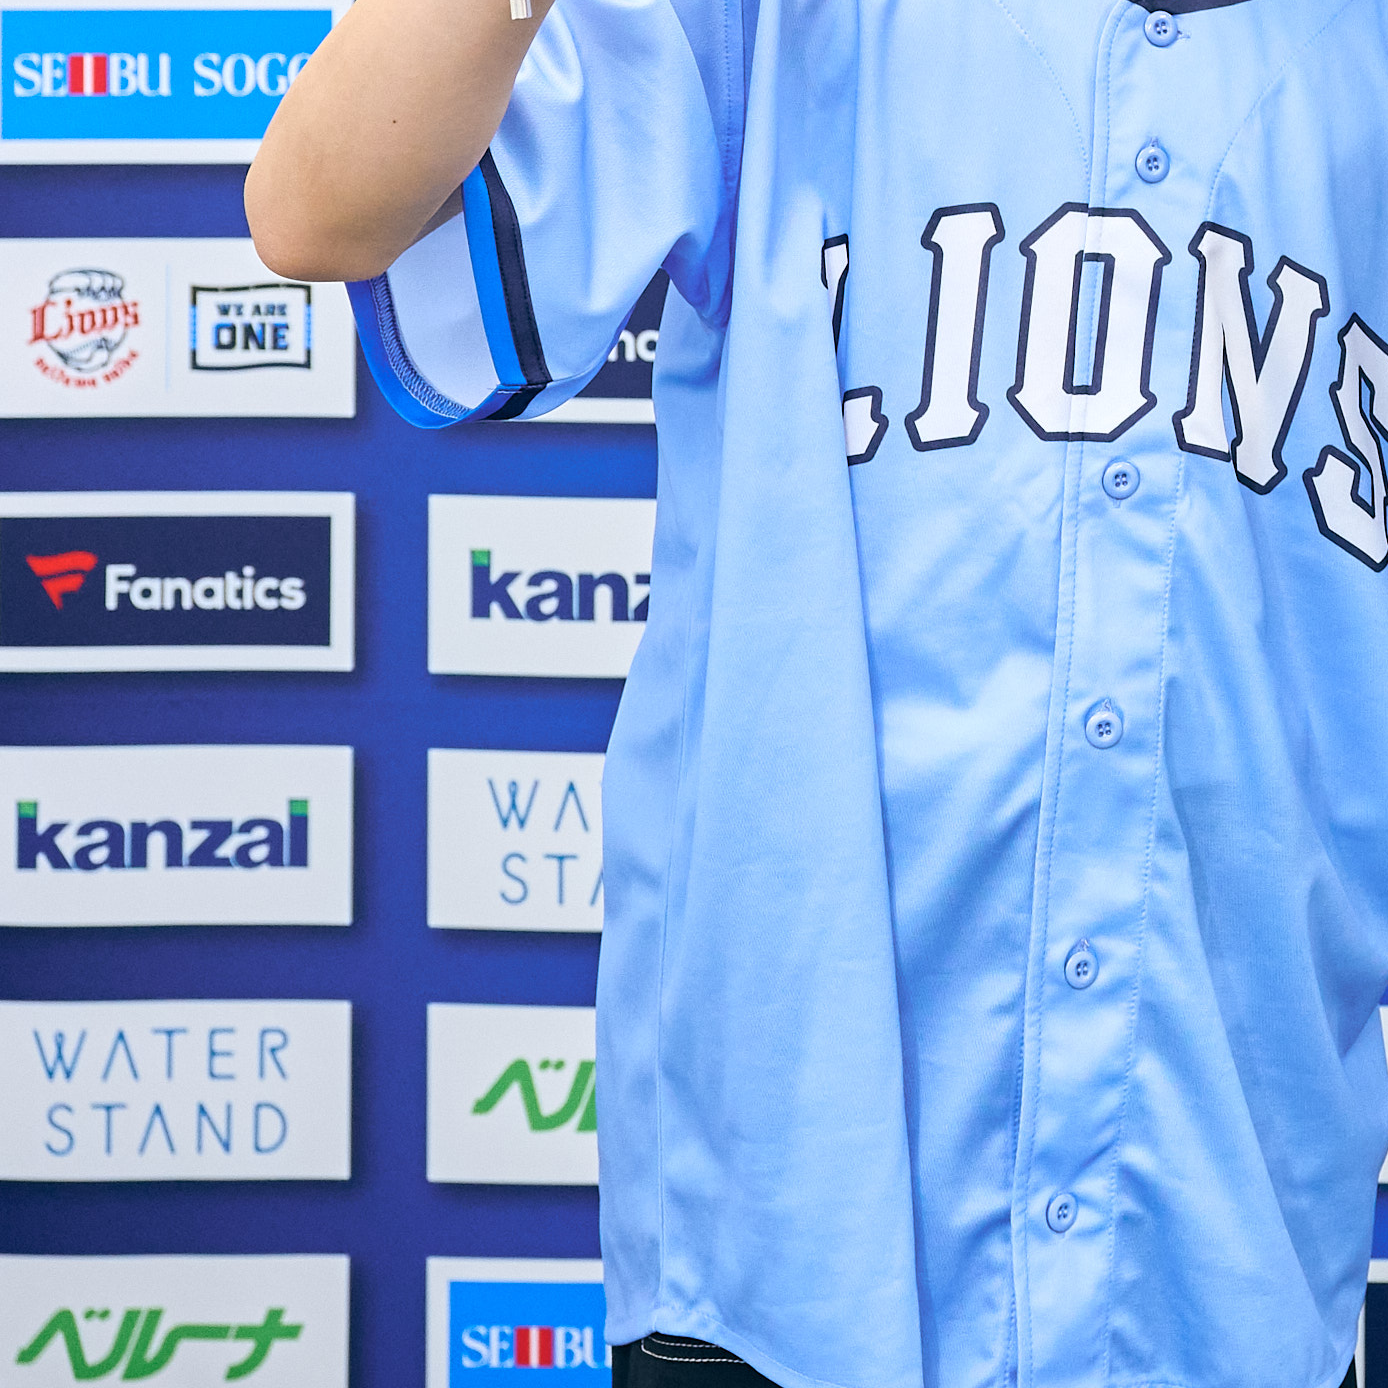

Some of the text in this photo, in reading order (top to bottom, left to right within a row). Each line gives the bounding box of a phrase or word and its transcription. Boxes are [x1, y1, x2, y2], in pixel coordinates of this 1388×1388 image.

[14, 53, 170, 96] SEIBU
[27, 297, 141, 346] Lions
[217, 304, 287, 316] WE ARE
[214, 322, 289, 351] ONE
[106, 564, 306, 610] Fanatics
[16, 799, 309, 872] kanzai
[33, 1027, 289, 1082] WATER
[45, 1102, 288, 1157] STAND
[15, 1308, 303, 1382] ベルーナ
